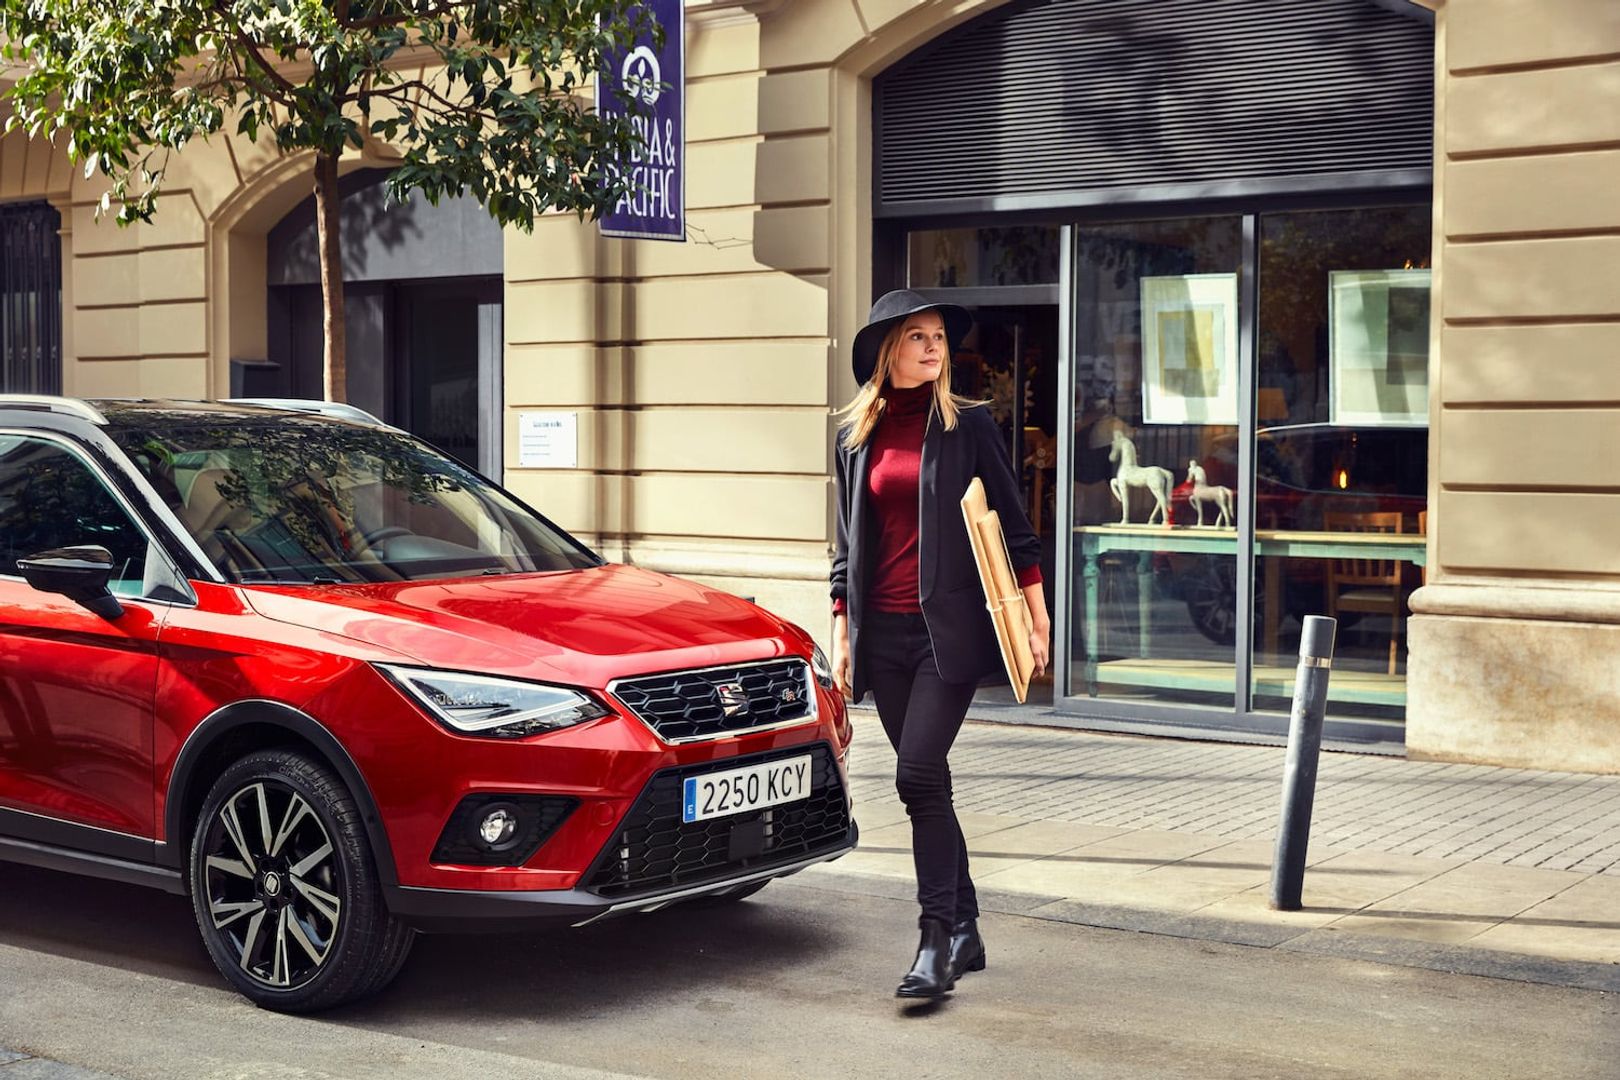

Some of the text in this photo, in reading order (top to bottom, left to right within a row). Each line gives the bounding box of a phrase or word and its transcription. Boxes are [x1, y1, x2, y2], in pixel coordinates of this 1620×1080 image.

[664, 118, 676, 167] &
[687, 763, 806, 815] E 2250 KCY
